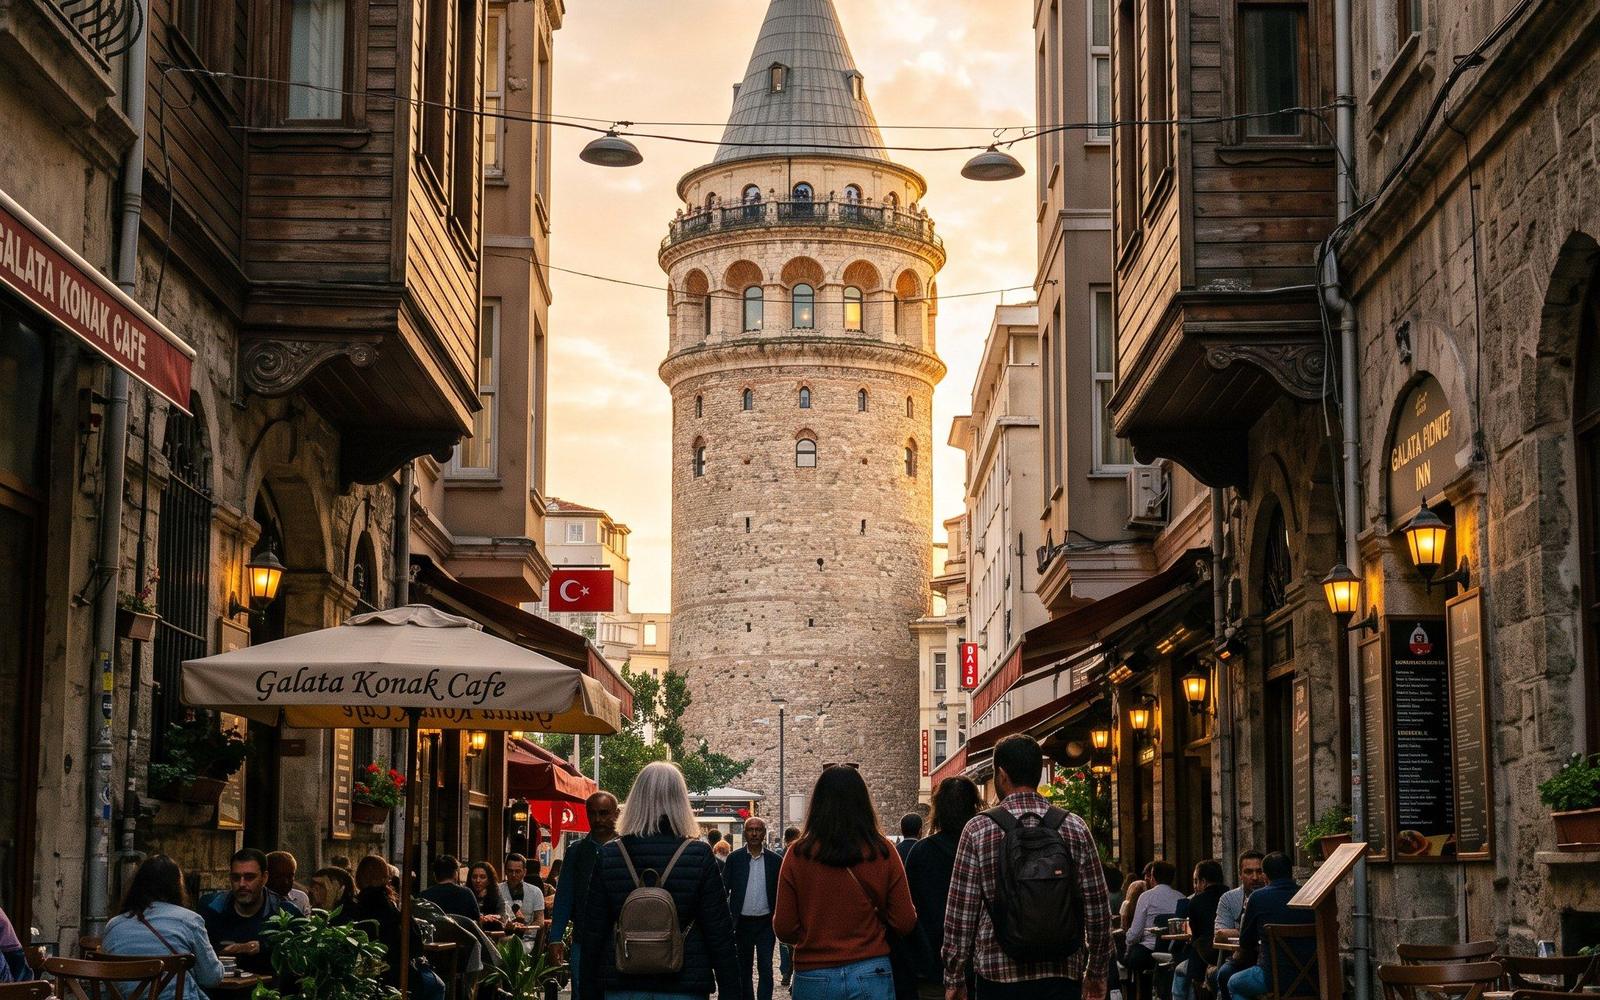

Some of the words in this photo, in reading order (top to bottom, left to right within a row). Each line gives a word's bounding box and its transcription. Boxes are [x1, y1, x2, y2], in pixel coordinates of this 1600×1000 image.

[59, 271, 109, 343] KONAK
[113, 314, 147, 371] CAFE
[1391, 432, 1422, 472] GALATA
[1415, 459, 1431, 491] INN
[256, 667, 344, 700] Galata
[351, 669, 444, 701] Konak
[447, 671, 507, 704] Cafe
